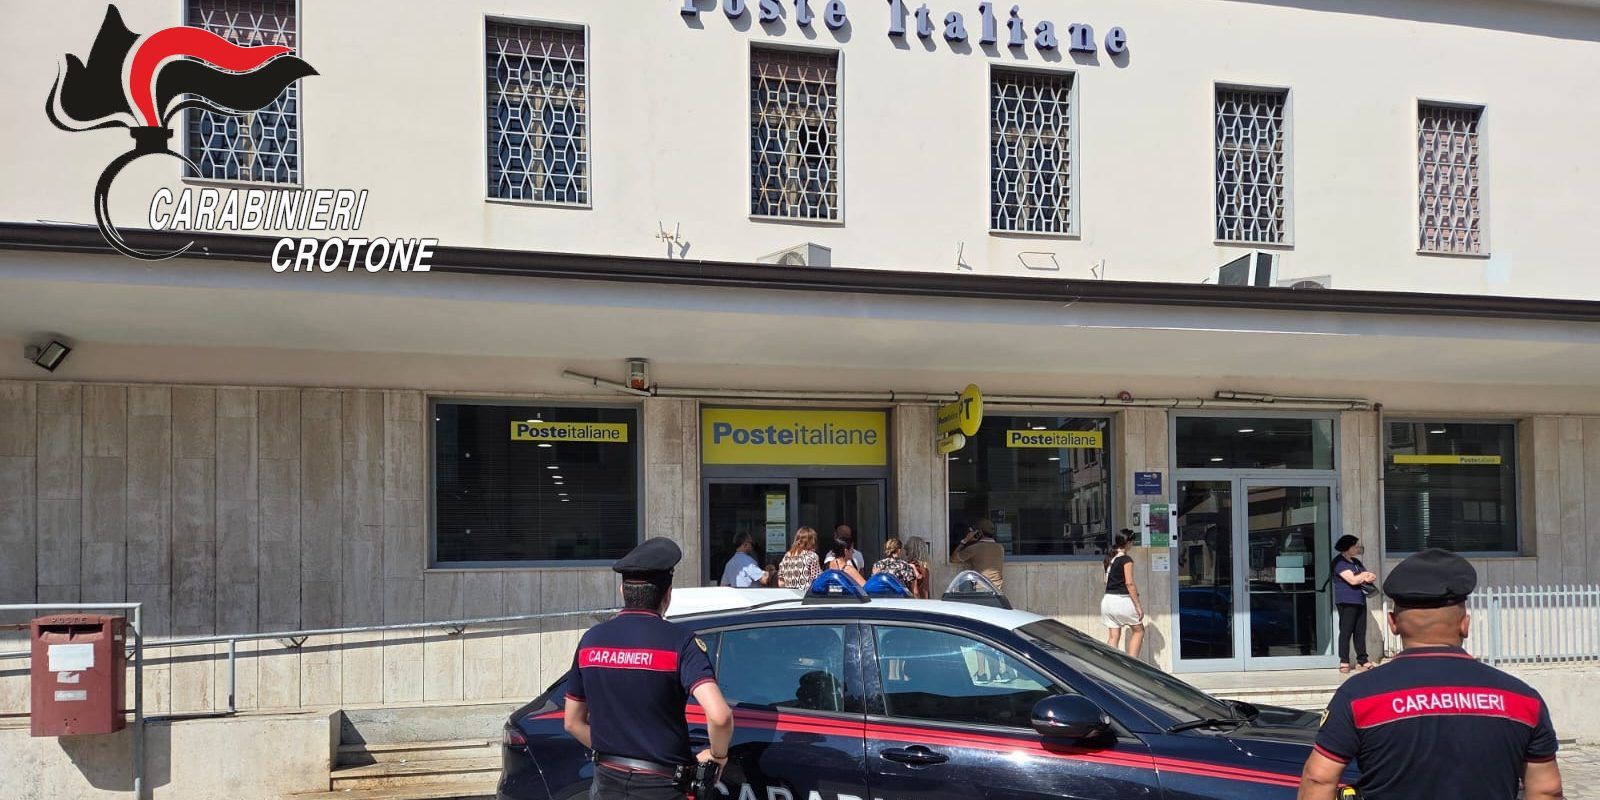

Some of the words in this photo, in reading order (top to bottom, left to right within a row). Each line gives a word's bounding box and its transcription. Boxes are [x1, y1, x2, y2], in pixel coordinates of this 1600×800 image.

[680, 0, 847, 30] oste
[888, 0, 1128, 54] Italiane
[517, 423, 620, 439] Posteitaliane
[712, 422, 878, 445] Posteitaliane
[1011, 432, 1096, 446] Posteitaliane
[588, 650, 653, 666] CARABINIERI
[1392, 692, 1506, 713] CARABINIERI
